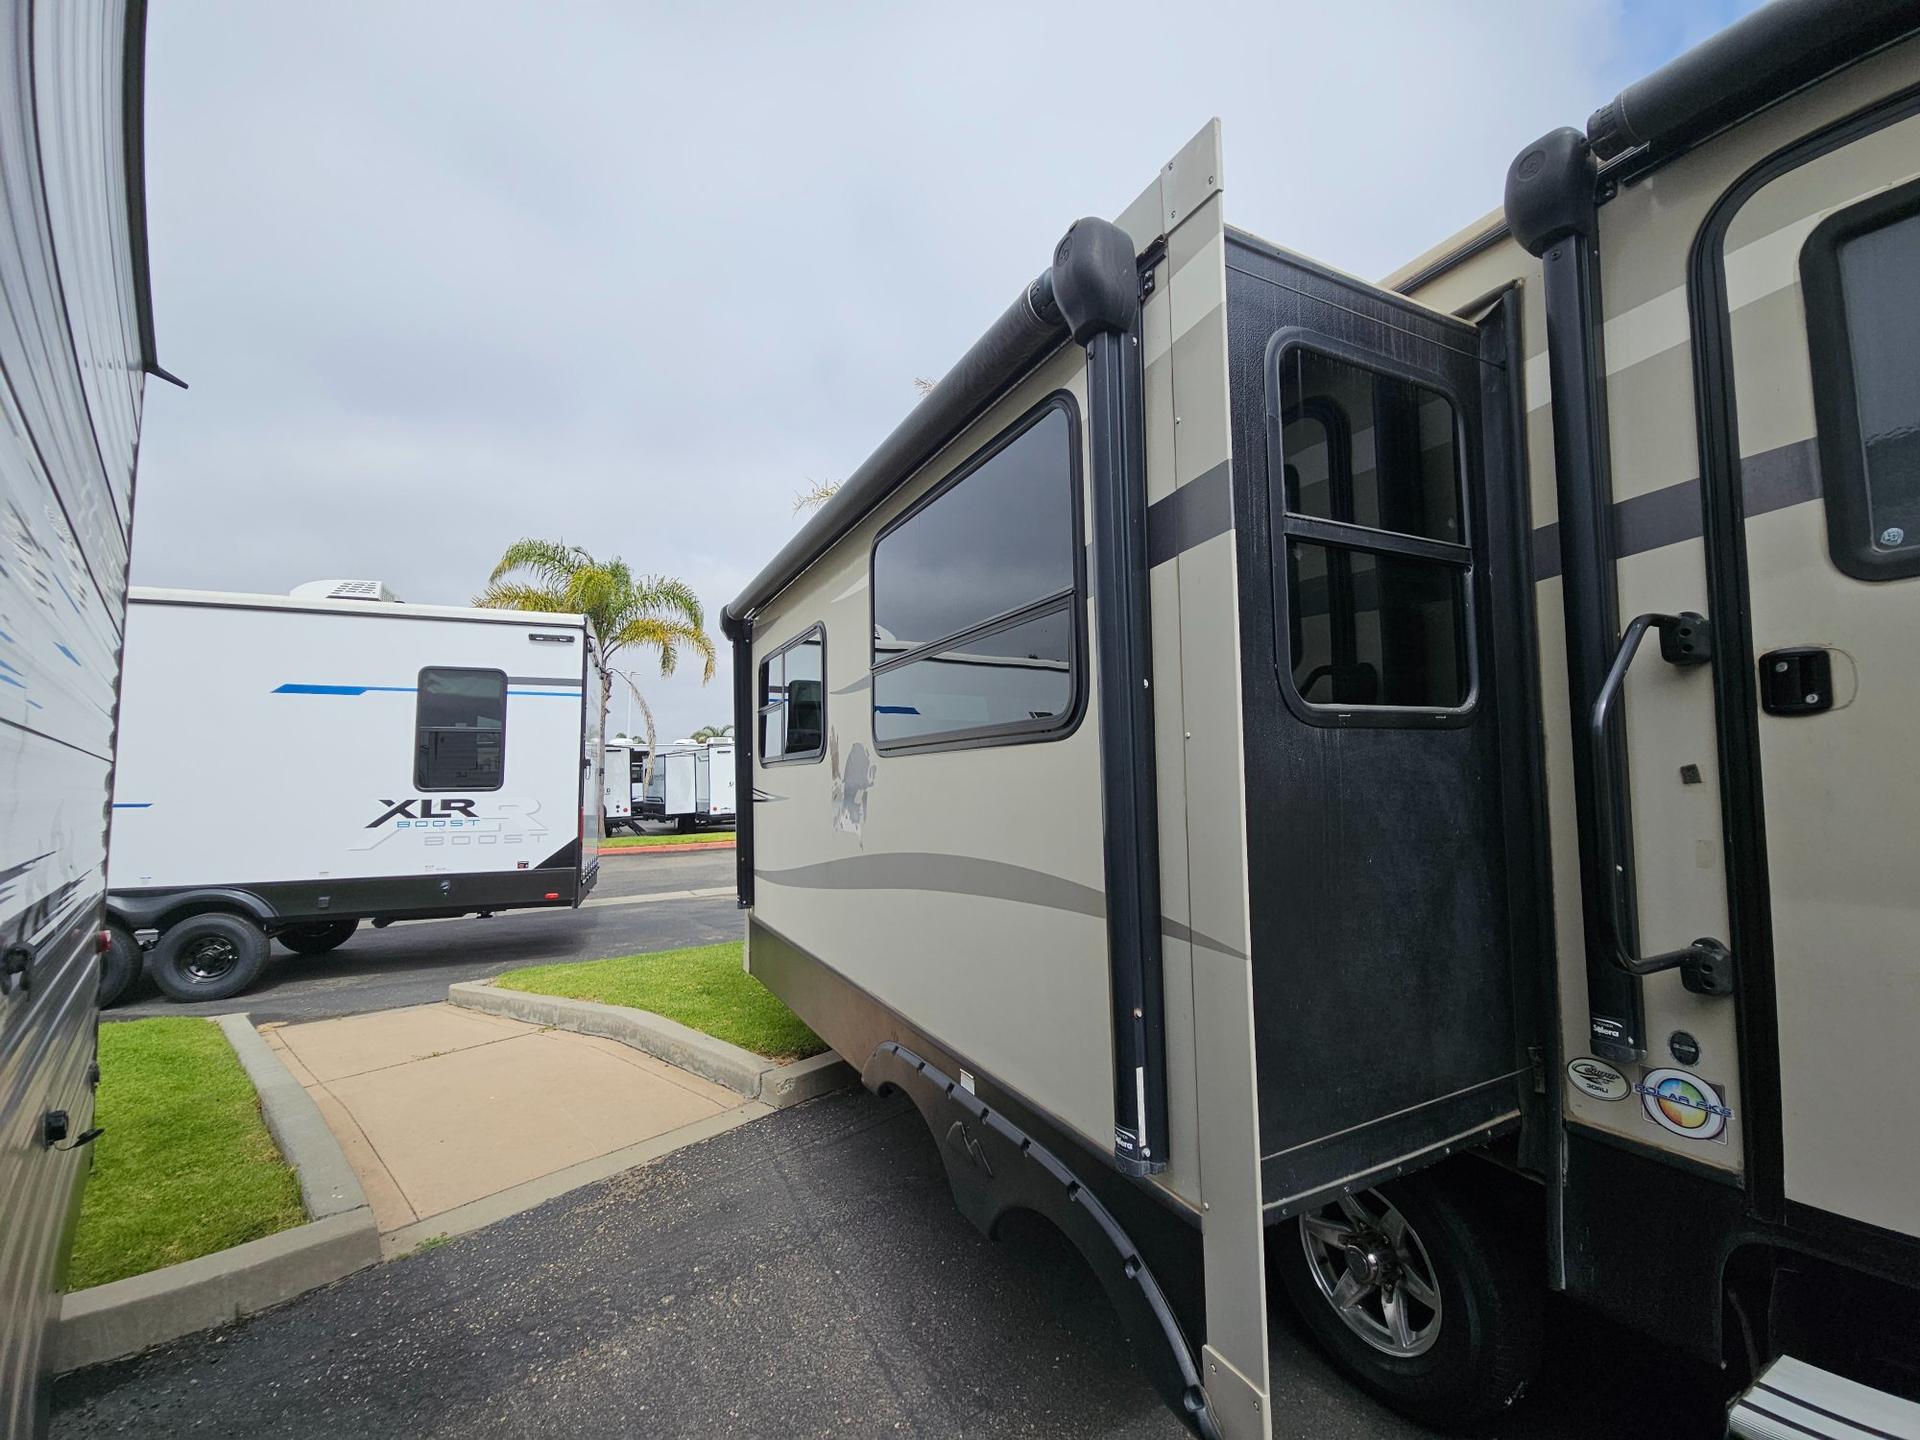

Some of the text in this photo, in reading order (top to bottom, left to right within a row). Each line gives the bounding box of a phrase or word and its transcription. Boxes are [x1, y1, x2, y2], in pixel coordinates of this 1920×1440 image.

[363, 799, 479, 828] XLR
[396, 819, 481, 829] BOOST
[424, 833, 549, 847] BOOST
